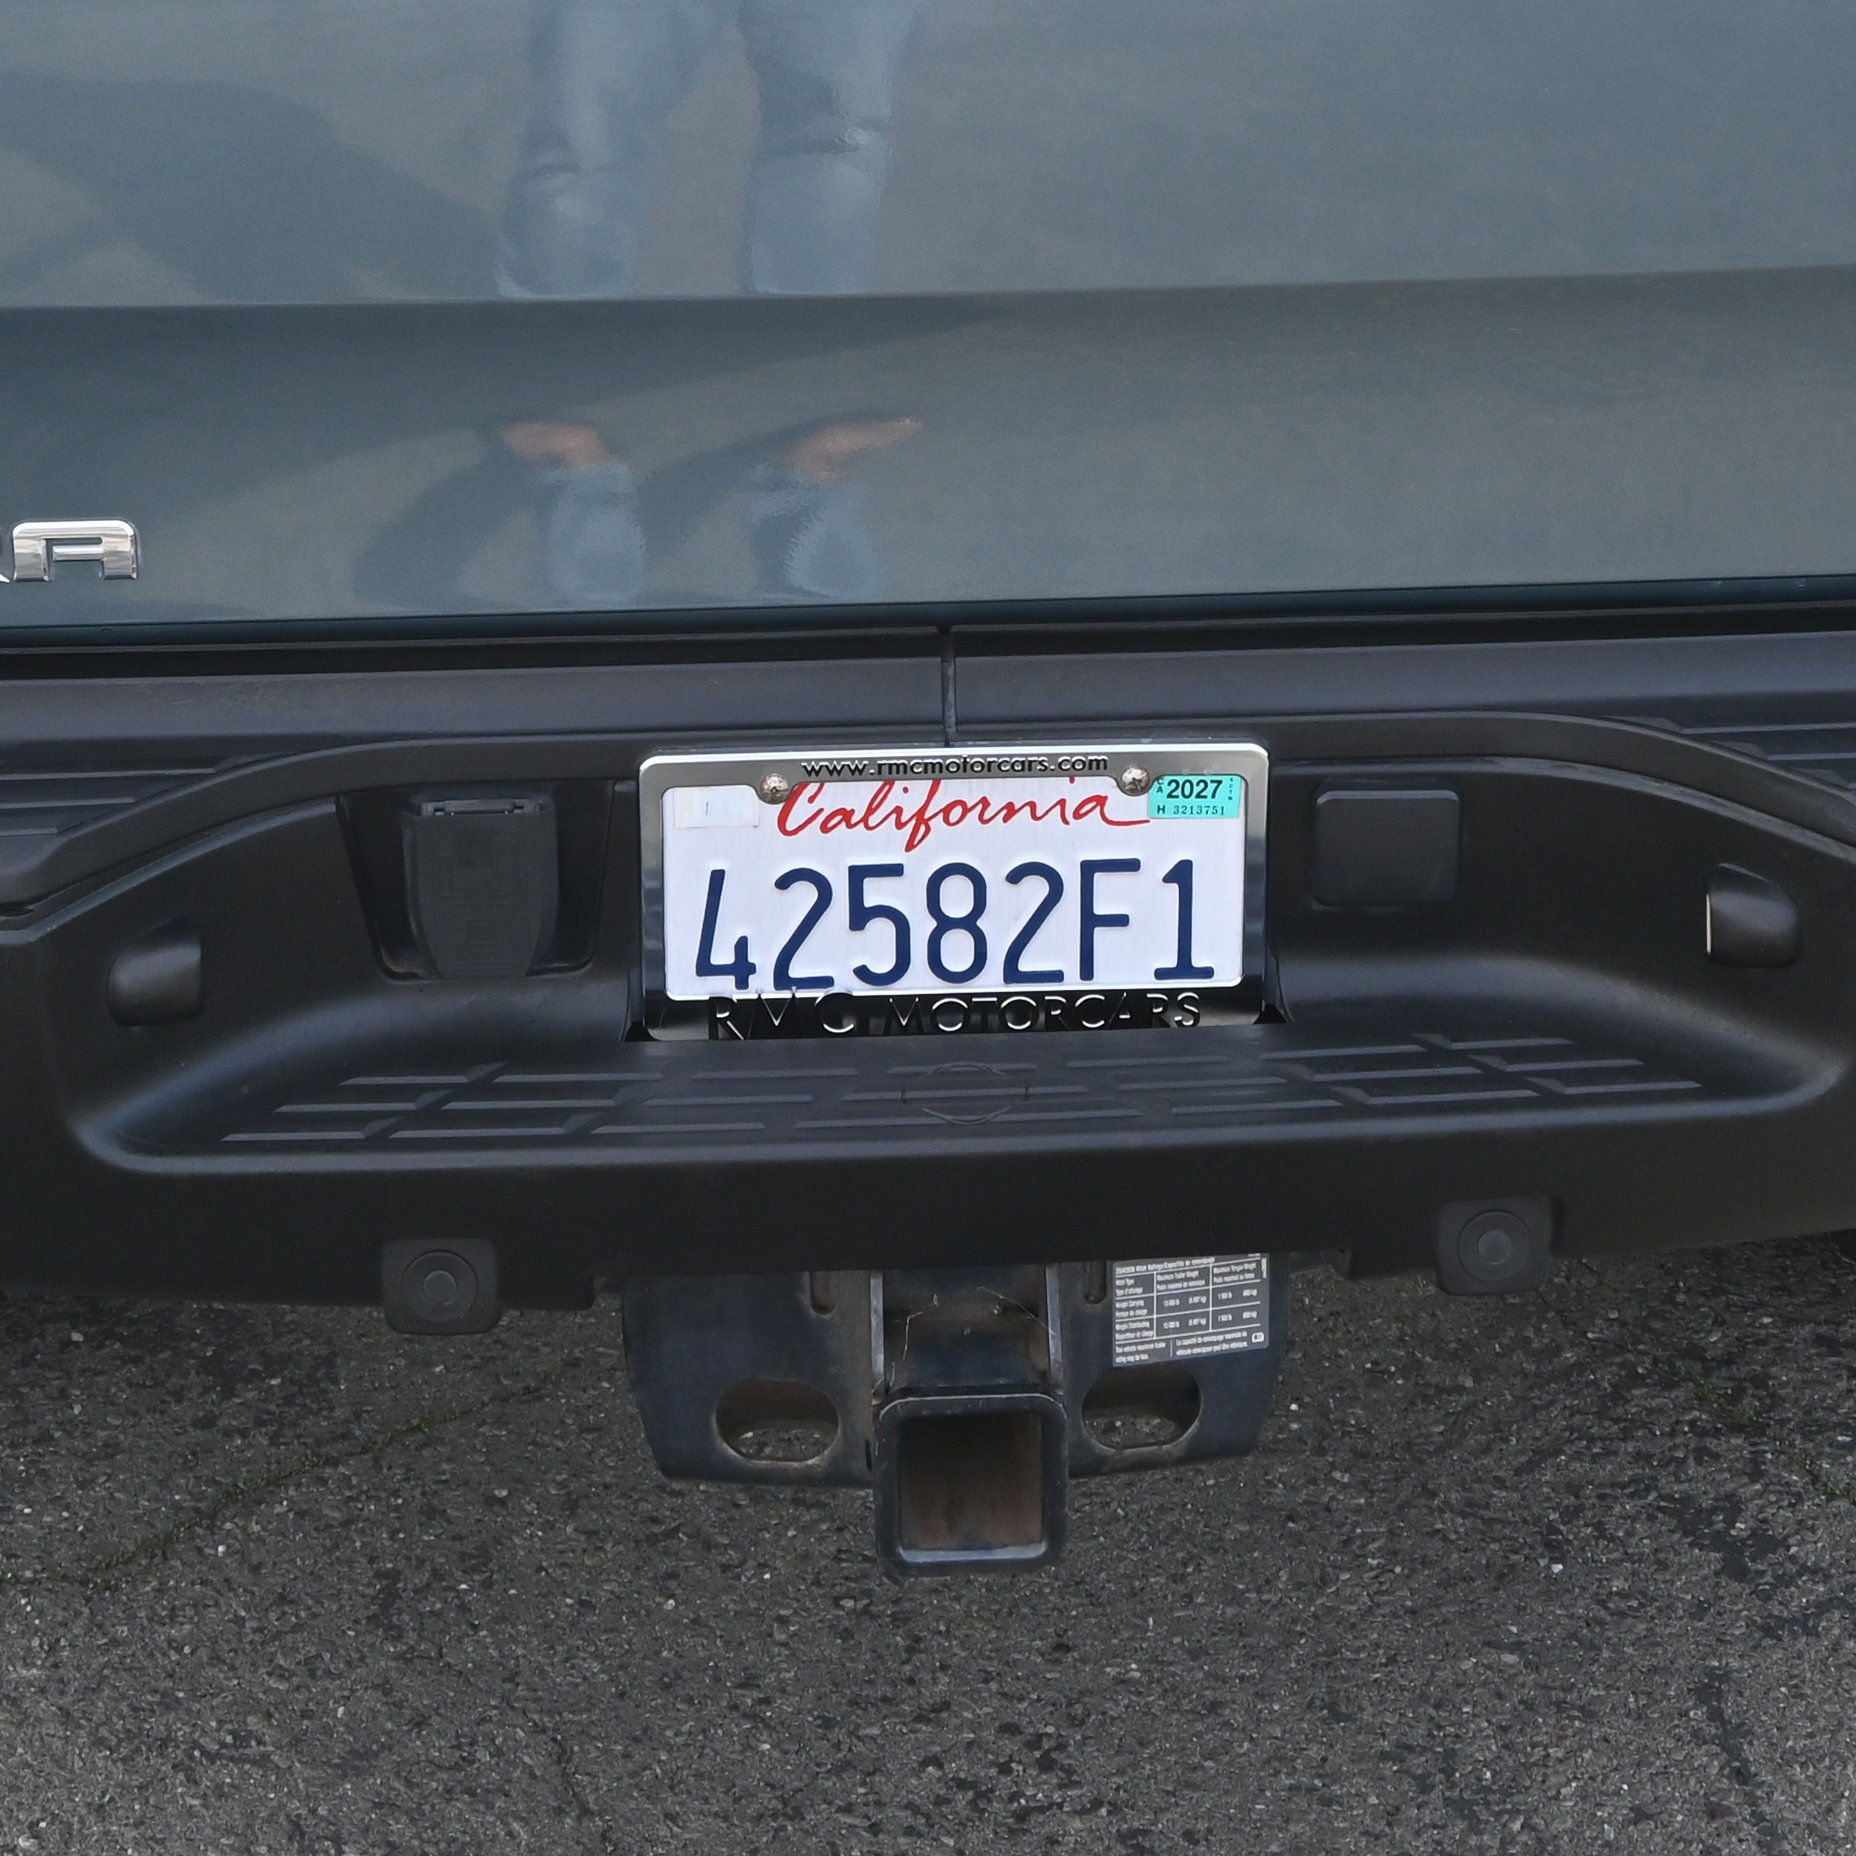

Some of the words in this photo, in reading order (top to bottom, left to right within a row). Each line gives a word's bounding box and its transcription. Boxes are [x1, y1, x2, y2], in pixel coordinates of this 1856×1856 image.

[801, 753, 1109, 777] www.rmcmotorcars.com
[1166, 779, 1223, 799] 2027
[776, 778, 1151, 853] California
[1156, 805, 1166, 814] H
[1173, 805, 1225, 815] 3213751
[694, 857, 1215, 991] 42582F1
[708, 987, 857, 1041] RMC
[881, 992, 1202, 1036] MOTORCARS
